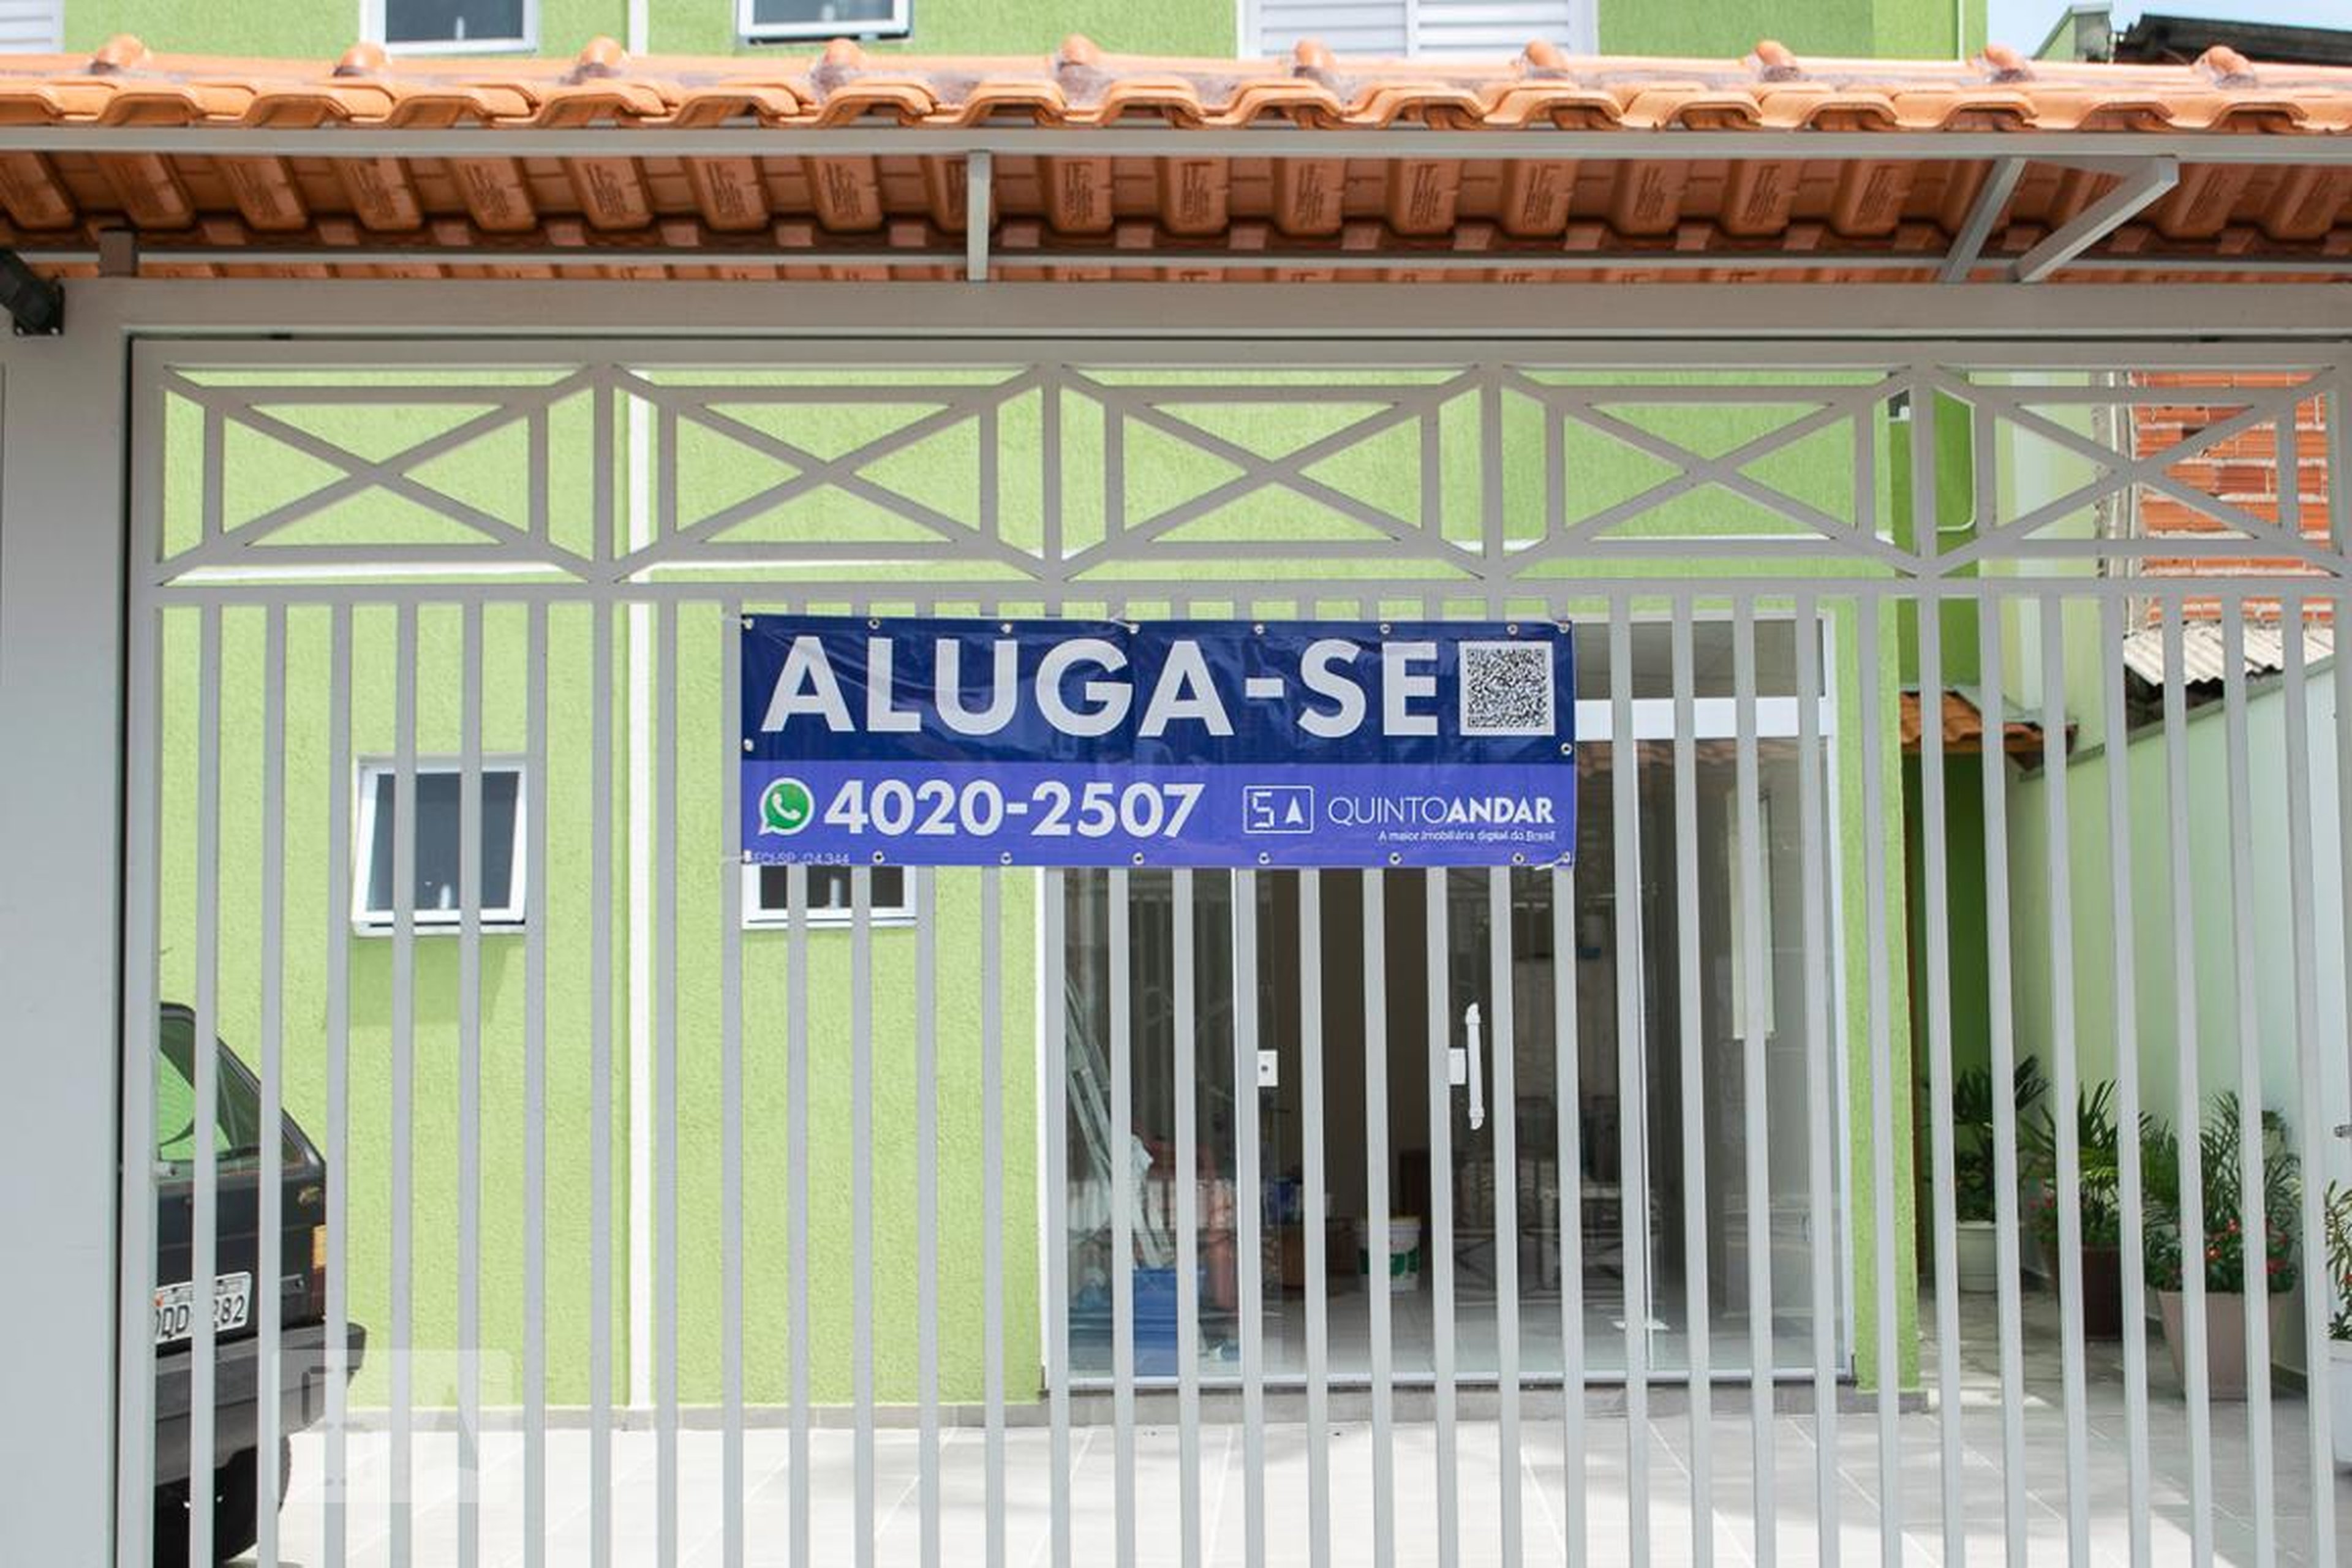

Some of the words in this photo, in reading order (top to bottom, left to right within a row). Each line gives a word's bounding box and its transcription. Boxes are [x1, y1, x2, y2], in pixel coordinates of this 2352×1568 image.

[761, 636, 1438, 737] ALUGA-SE
[824, 779, 1205, 838] 4020-2507
[1328, 796, 1555, 826] QUINTOANDAR
[1378, 829, 1387, 844] A
[1510, 830, 1524, 841] do
